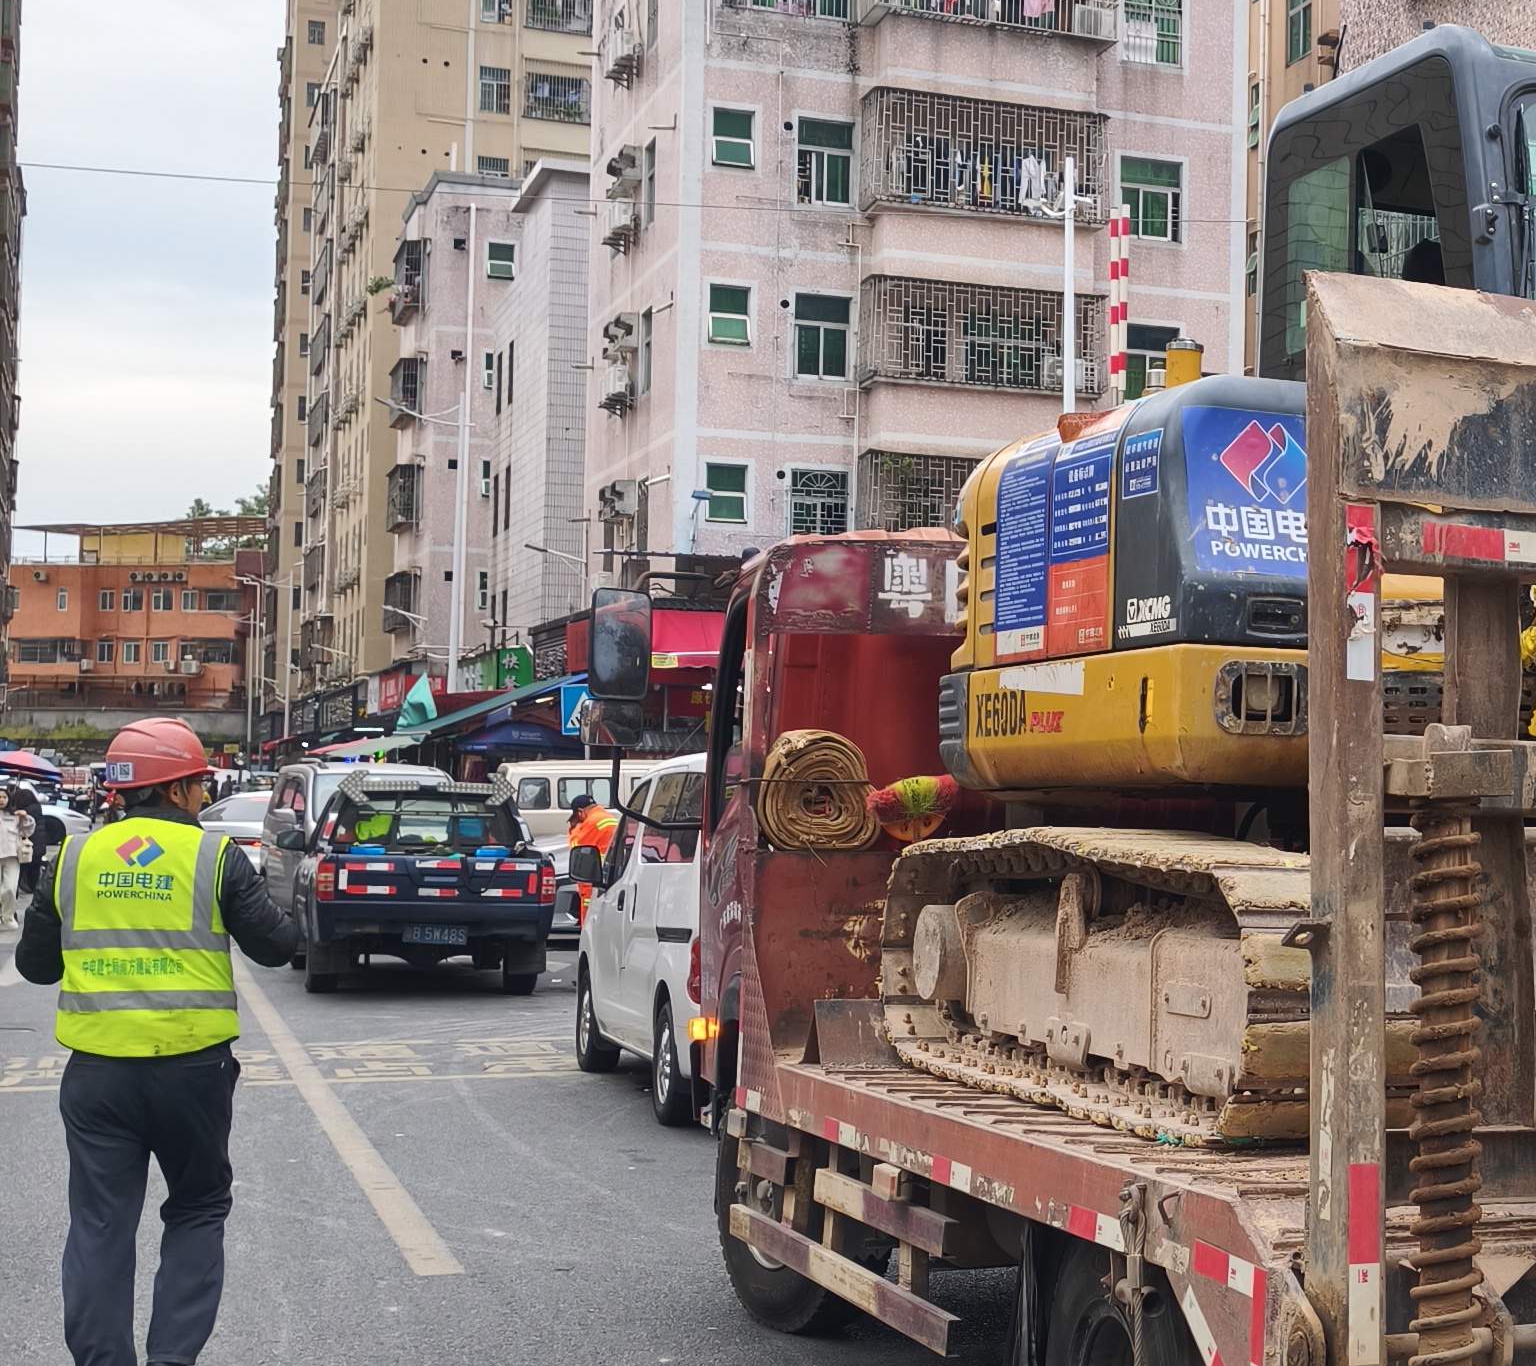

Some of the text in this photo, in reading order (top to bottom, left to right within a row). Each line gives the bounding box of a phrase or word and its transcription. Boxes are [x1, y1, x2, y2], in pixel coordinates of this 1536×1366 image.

[975, 689, 1028, 738] XE60DA
[98, 871, 175, 891] 中国电建
[96, 889, 173, 902] POWERCHINA
